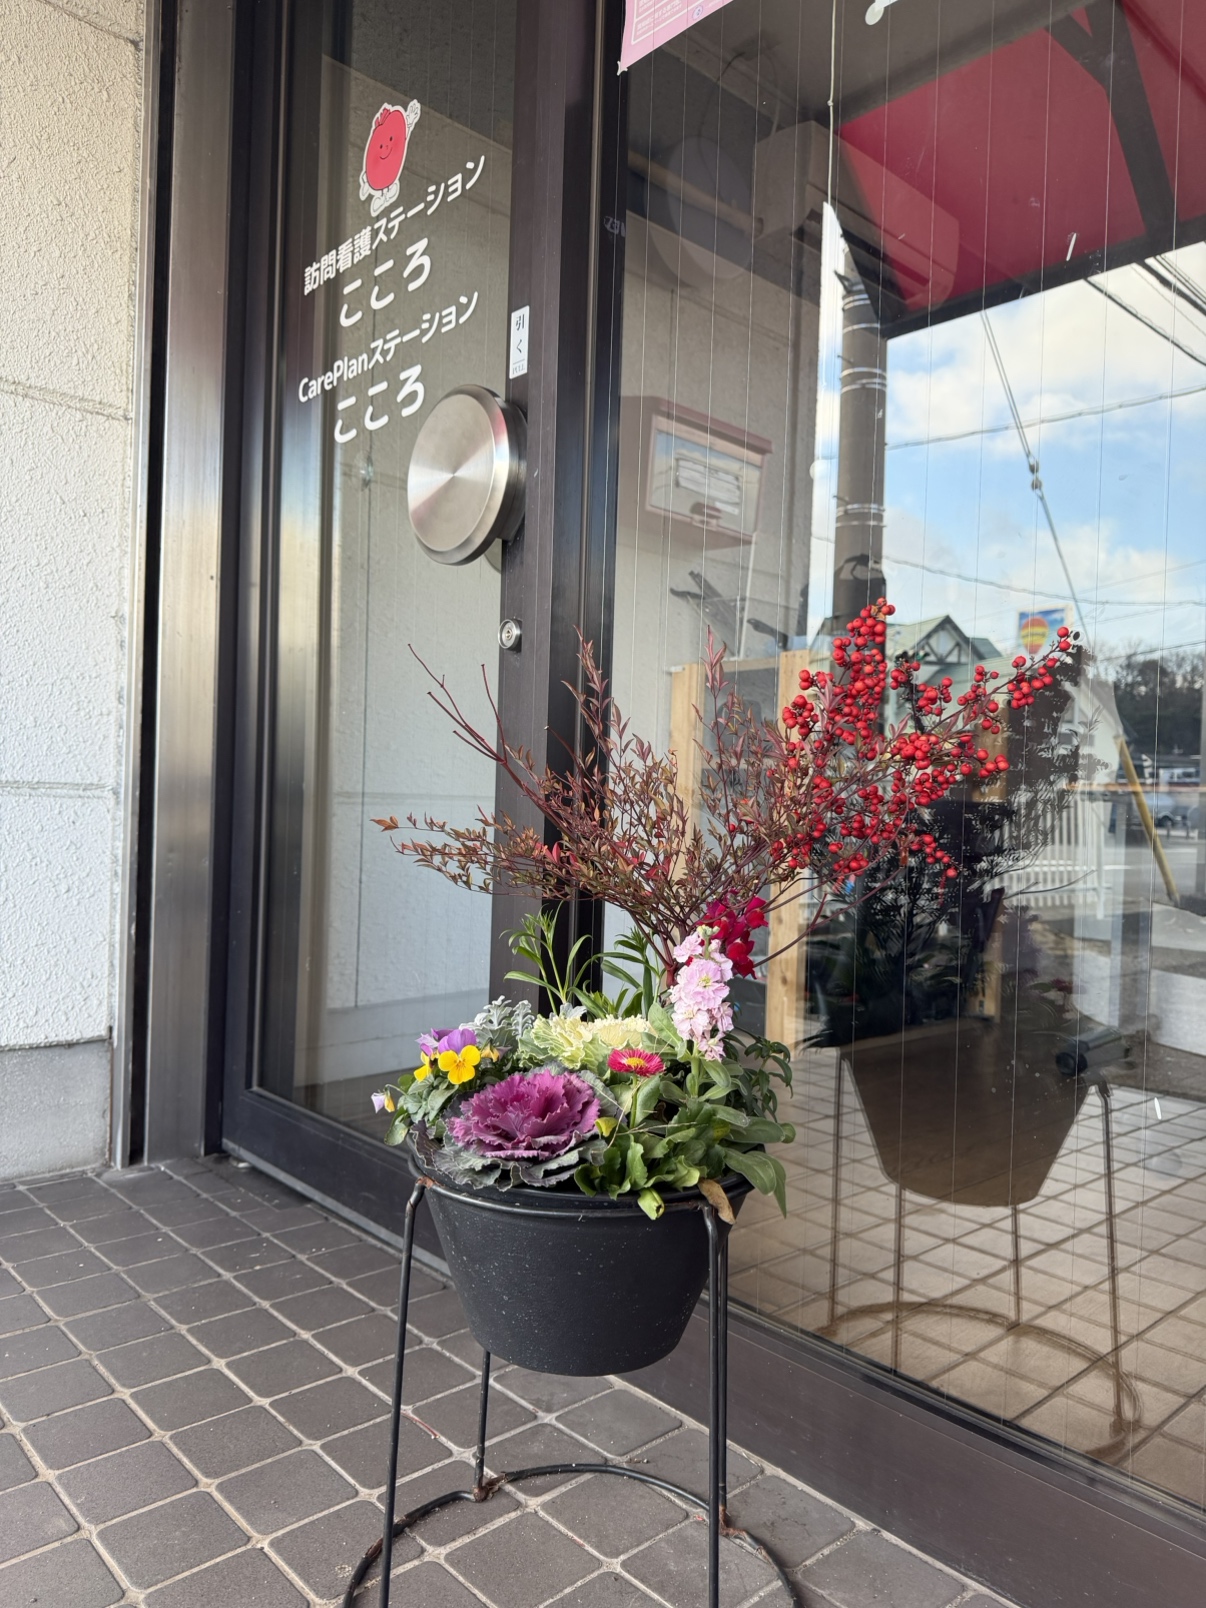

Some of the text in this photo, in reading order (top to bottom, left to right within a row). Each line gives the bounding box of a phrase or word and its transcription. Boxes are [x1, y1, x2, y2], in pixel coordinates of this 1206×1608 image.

[304, 155, 485, 295] 訪問看護ステーション
[339, 238, 432, 327] こころ
[298, 291, 478, 403] CarePlanステーション
[515, 313, 525, 354] 引く
[334, 364, 426, 444] こころ
